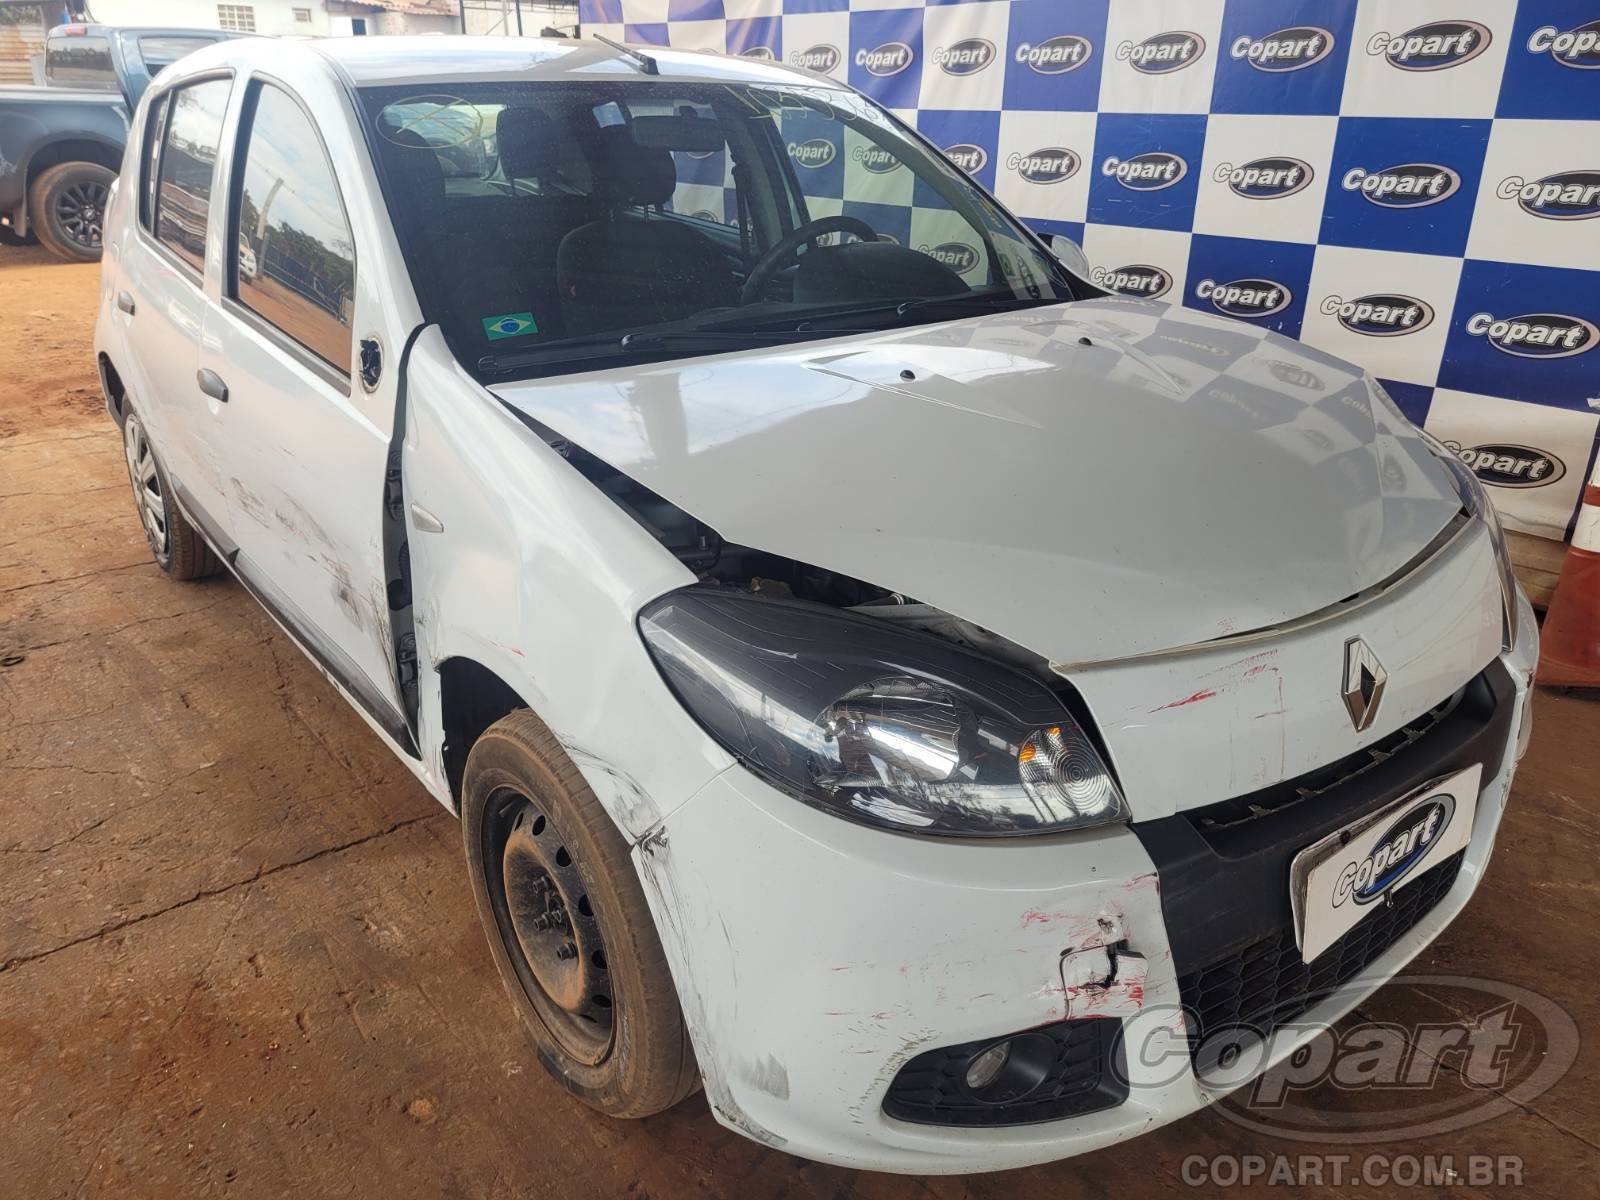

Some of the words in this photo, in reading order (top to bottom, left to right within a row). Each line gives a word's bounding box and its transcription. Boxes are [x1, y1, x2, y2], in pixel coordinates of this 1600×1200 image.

[932, 45, 986, 65] Copart
[1016, 42, 1081, 66] Copart
[1116, 39, 1191, 64] Copart
[1231, 34, 1321, 62] Copart
[1366, 28, 1474, 60] Copart
[790, 51, 834, 68] Copart
[855, 49, 906, 66] Copart
[787, 142, 830, 161] Copart
[948, 151, 978, 168] art
[1007, 152, 1072, 175] Copart
[1102, 156, 1176, 180] Copart
[1213, 162, 1300, 189] Copart
[1342, 168, 1446, 197] Copart
[1497, 176, 1600, 207] Copar
[1090, 266, 1161, 292] Copart
[1196, 279, 1281, 307] Copart
[1320, 295, 1419, 326] Copart
[1467, 313, 1584, 348] Copart
[1332, 800, 1441, 908] Copart
